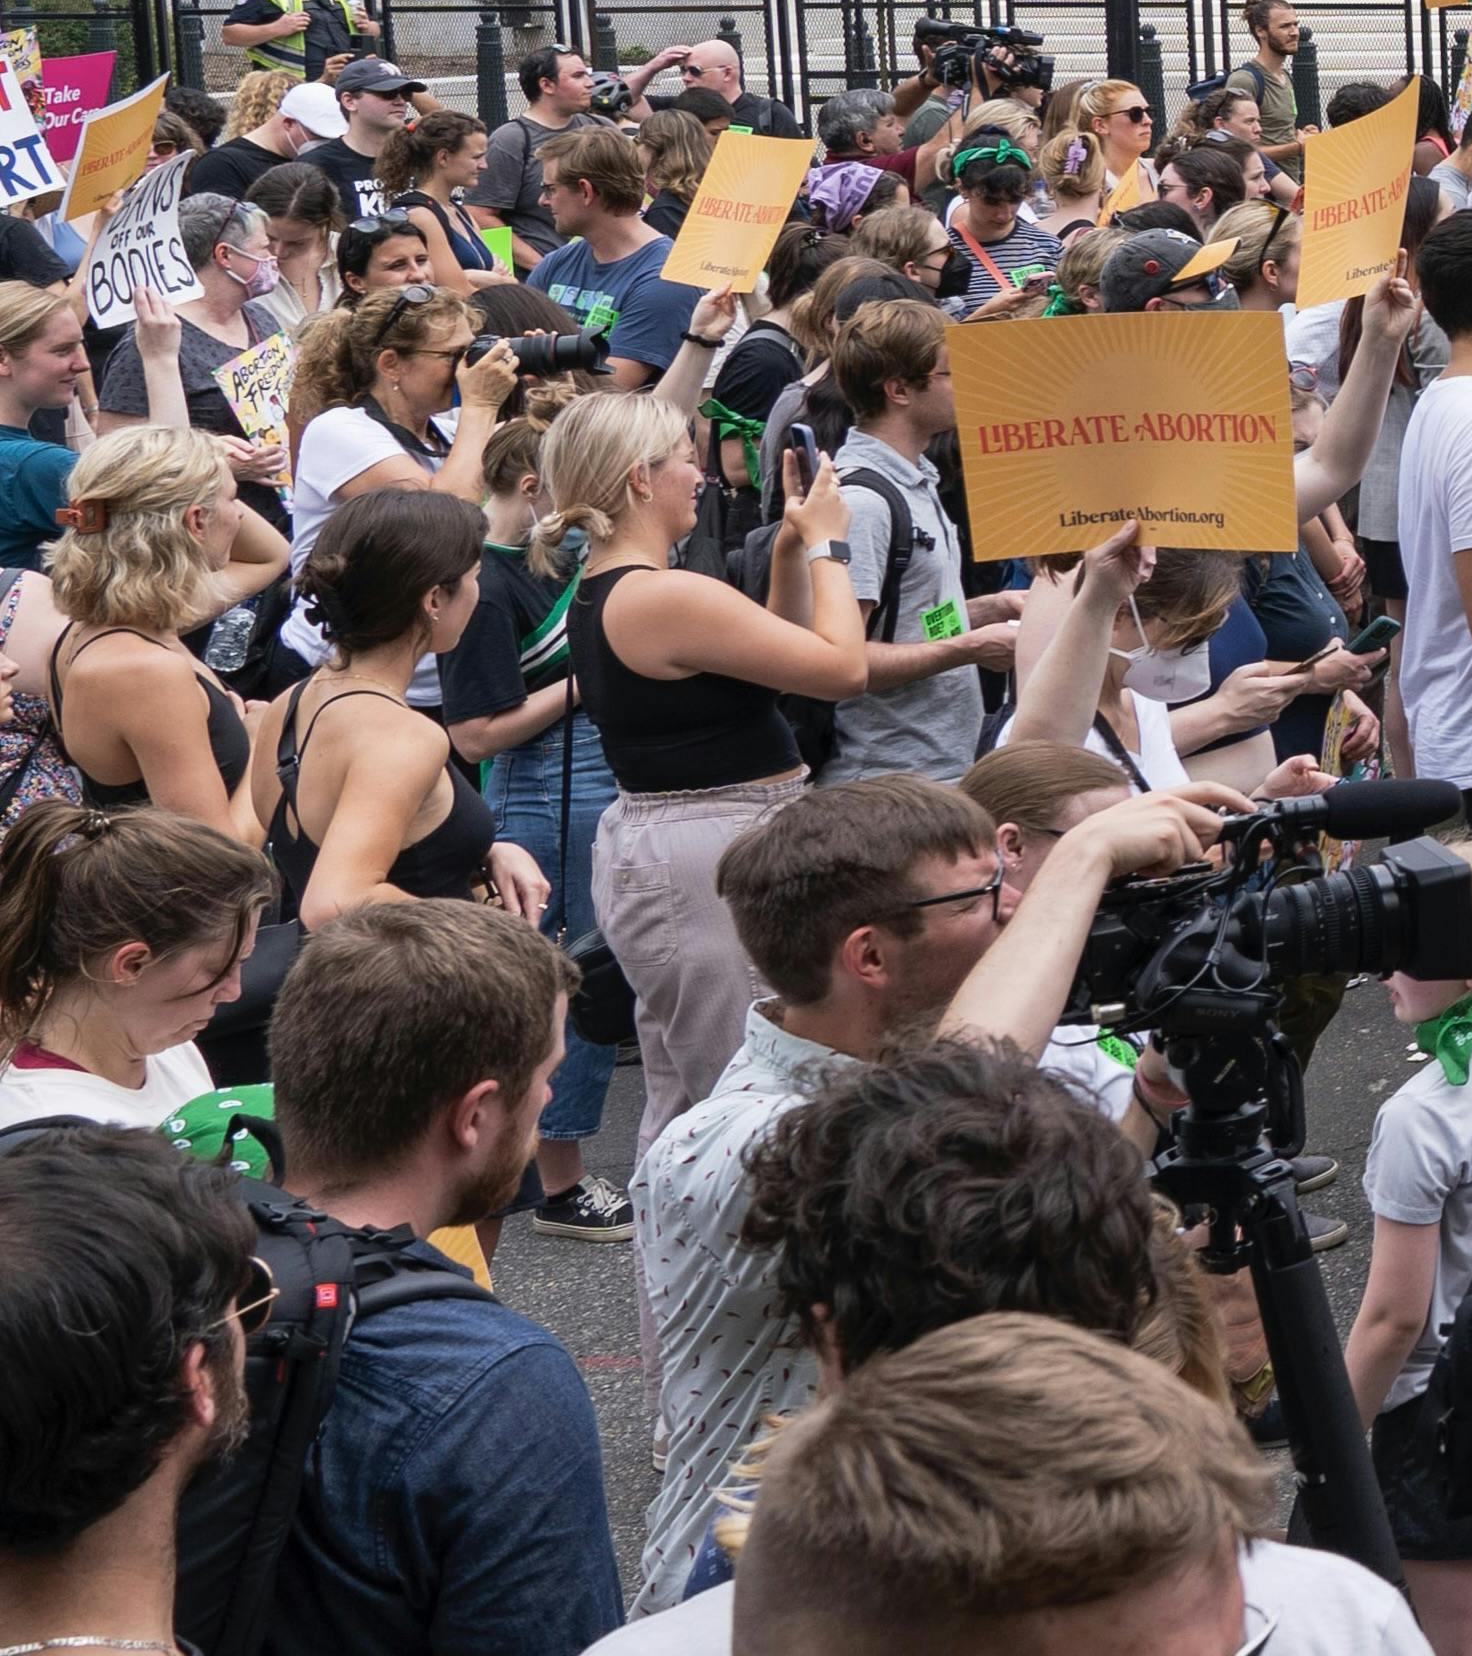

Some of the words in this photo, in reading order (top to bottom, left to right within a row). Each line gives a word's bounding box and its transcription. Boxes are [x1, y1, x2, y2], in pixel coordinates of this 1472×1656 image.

[44, 84, 81, 104] Take
[698, 196, 753, 224] LIBERATE
[1312, 187, 1388, 232] LIBERATE
[110, 228, 131, 249] OFF
[135, 222, 155, 241] OUR
[91, 237, 196, 316] BODIES
[1345, 257, 1401, 281] Liberate
[231, 343, 281, 403] ABORTION
[978, 414, 1129, 455] LIBERATE
[1134, 412, 1277, 445] ABORTION
[1059, 506, 1226, 529] LiberateAbortion.org
